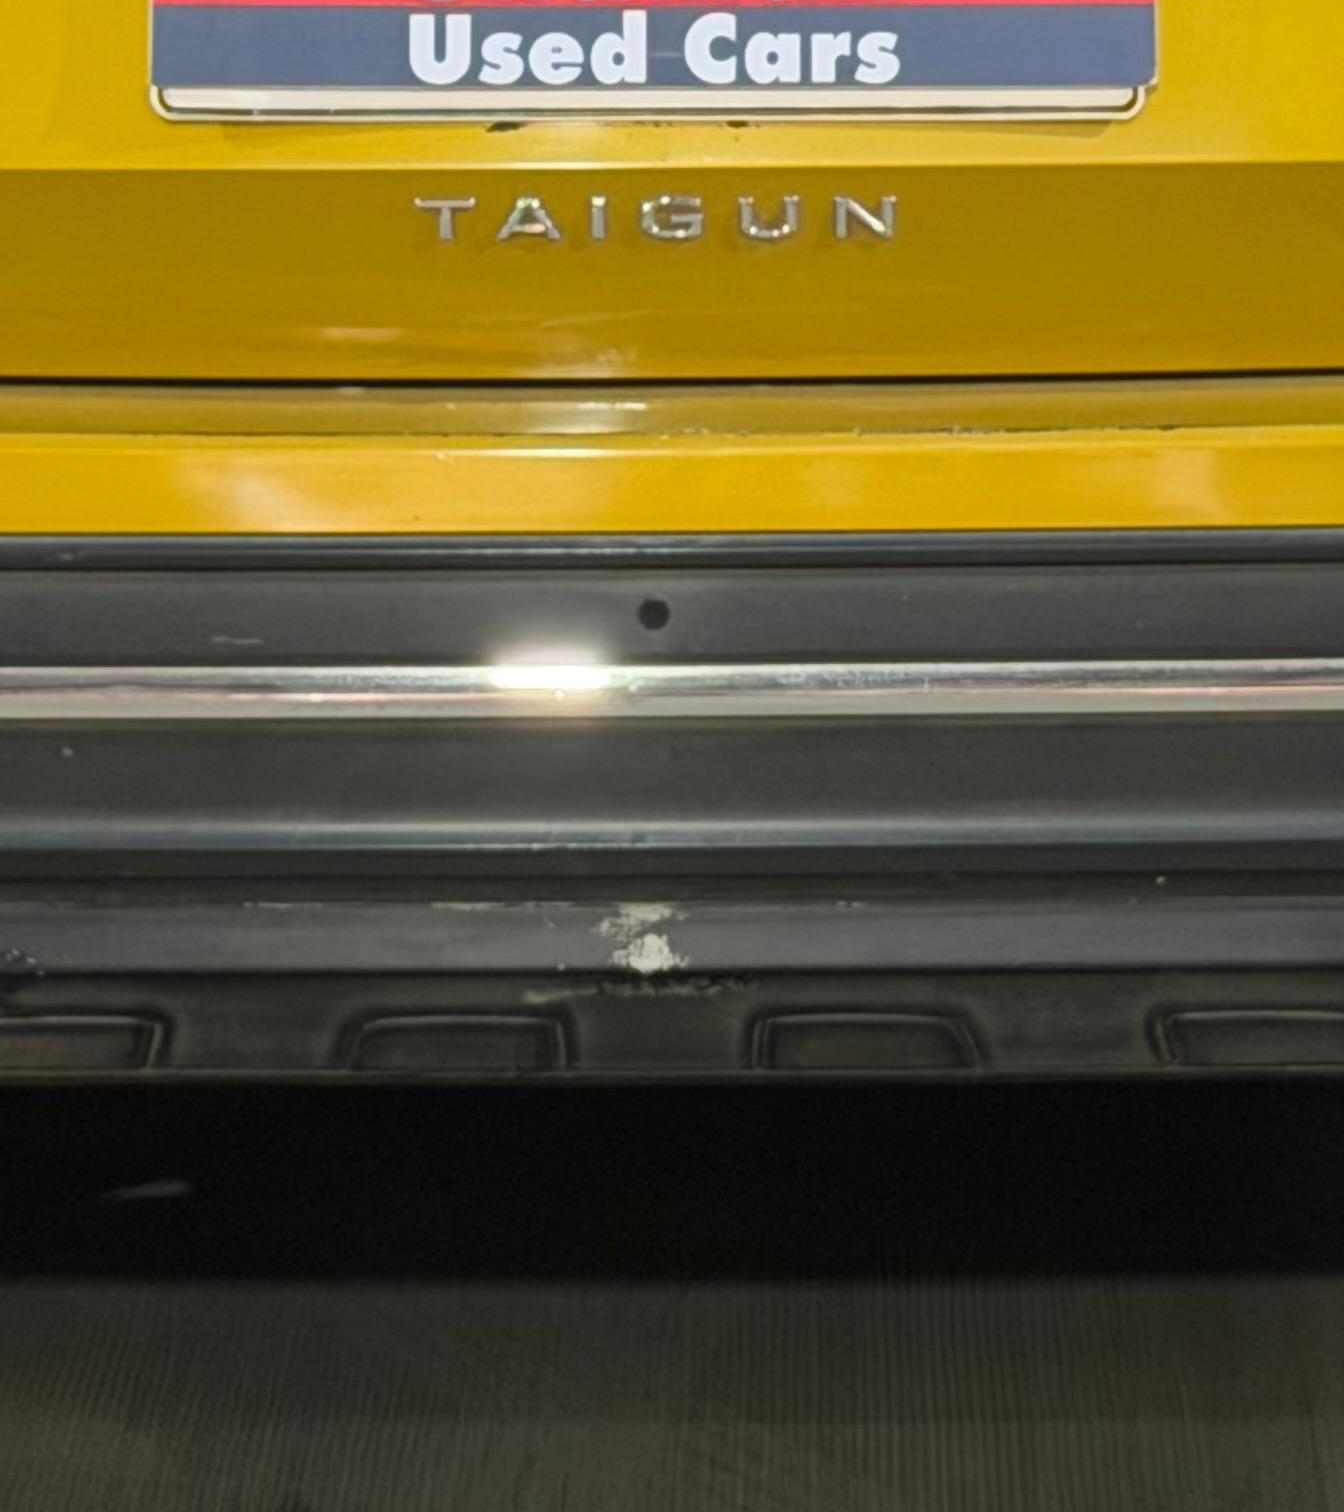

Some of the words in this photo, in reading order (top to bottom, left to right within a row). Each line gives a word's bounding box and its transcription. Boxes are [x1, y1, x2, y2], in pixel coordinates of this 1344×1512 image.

[409, 9, 647, 85] Used
[684, 12, 901, 85] Cars
[414, 195, 899, 241] TAIGUN
